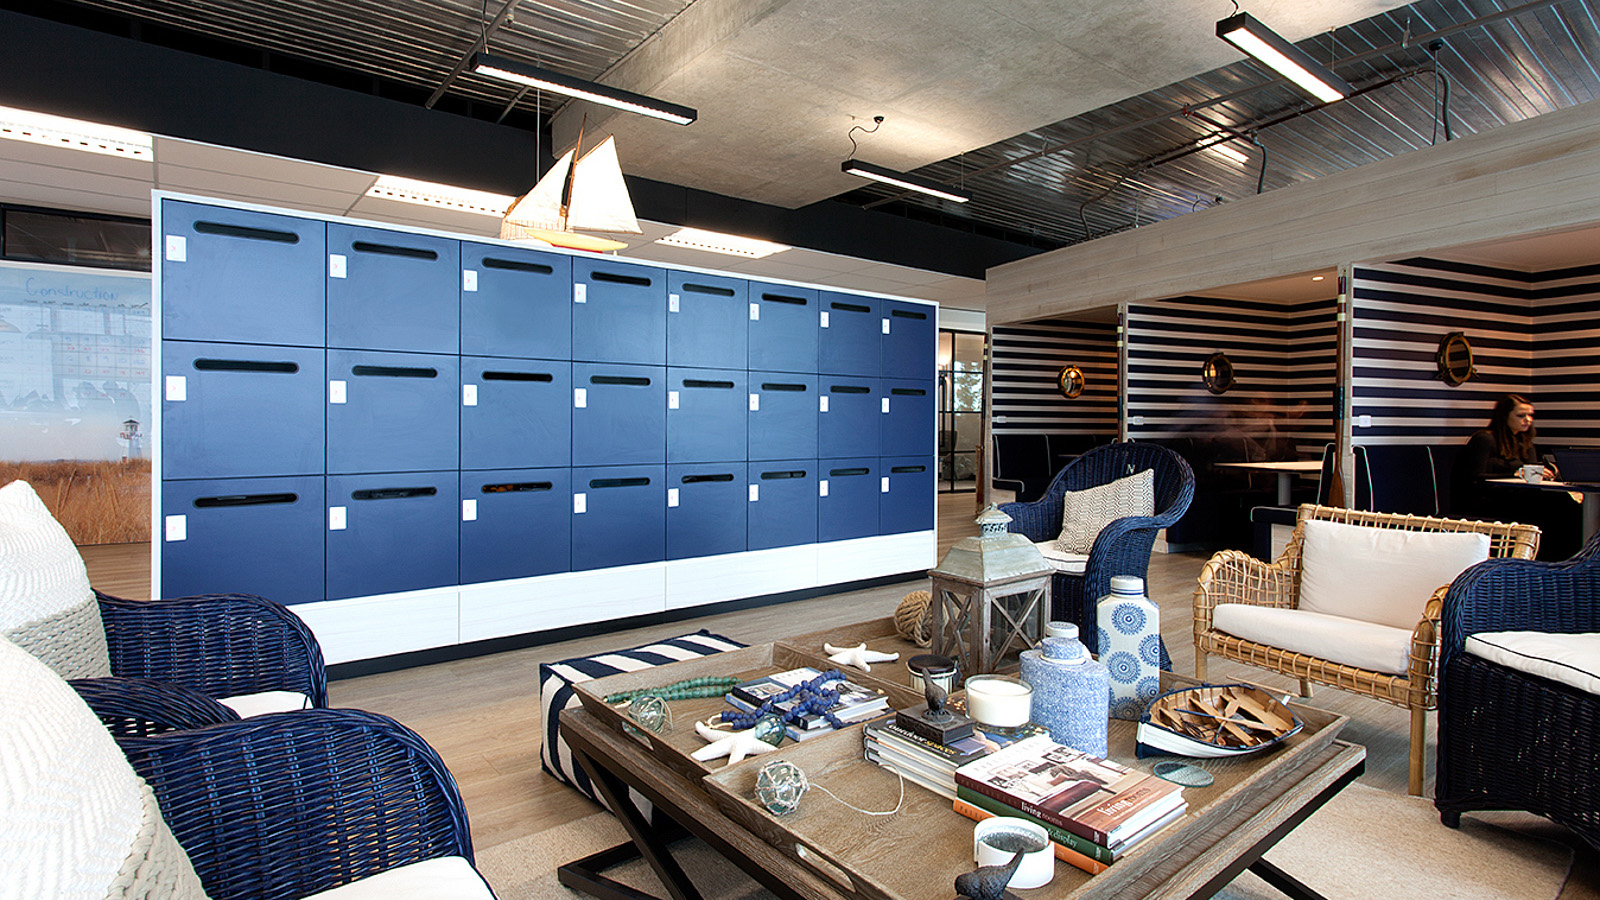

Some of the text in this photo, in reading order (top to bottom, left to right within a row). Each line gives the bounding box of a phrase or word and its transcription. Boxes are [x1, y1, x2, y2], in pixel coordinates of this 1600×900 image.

[25, 277, 118, 300] Construction
[1021, 801, 1064, 827] living rooms
[1097, 803, 1133, 816] living
[1053, 829, 1078, 848] display
